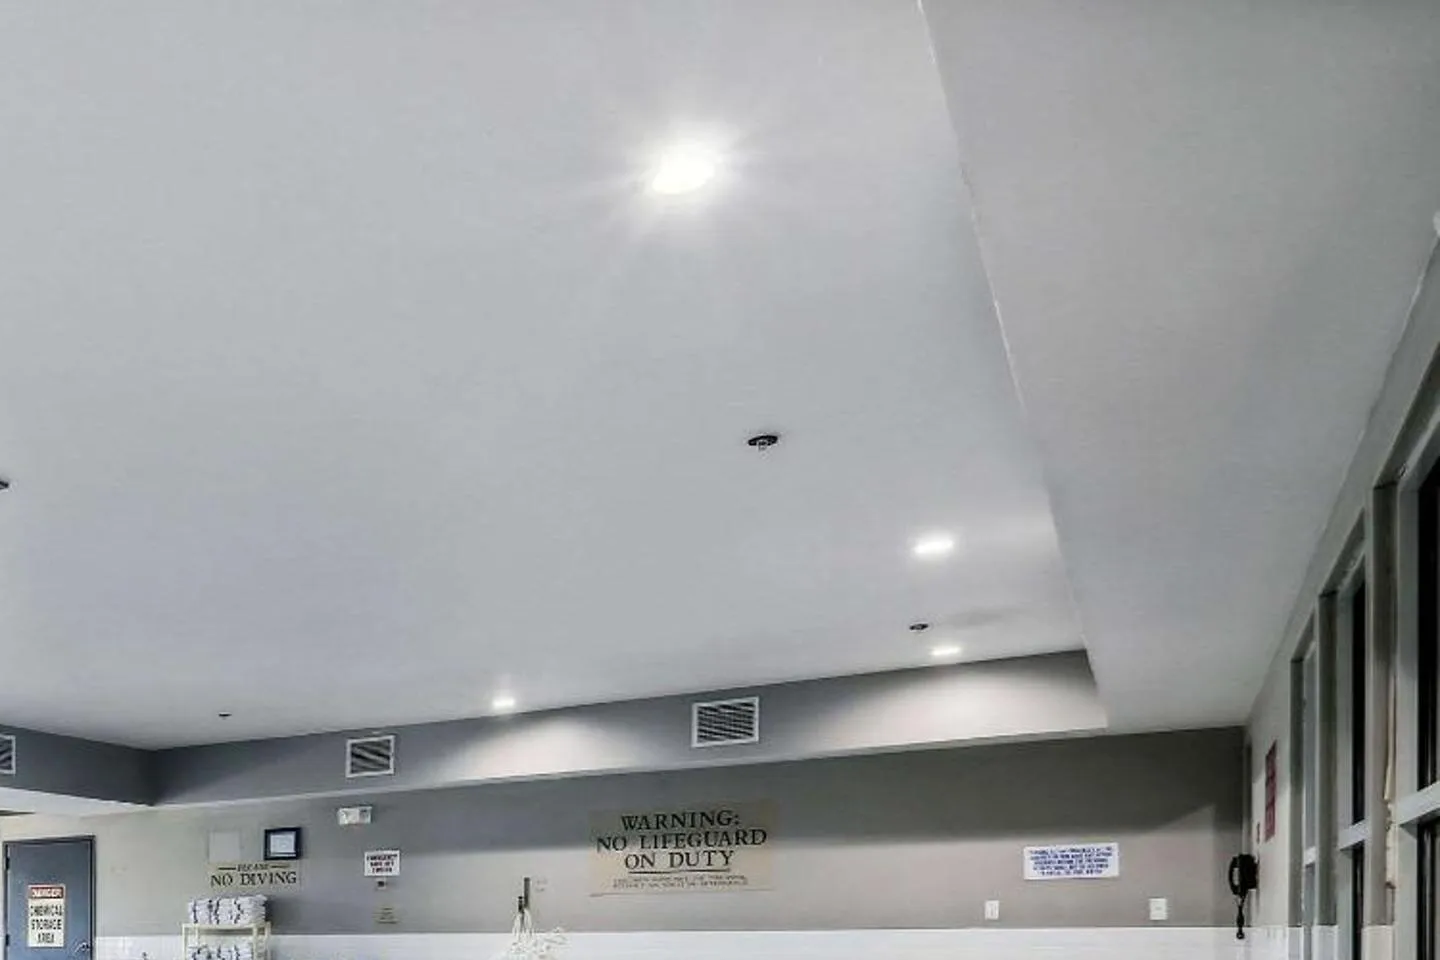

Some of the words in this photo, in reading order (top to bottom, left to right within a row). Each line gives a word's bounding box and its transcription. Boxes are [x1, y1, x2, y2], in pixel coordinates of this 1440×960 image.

[620, 810, 740, 831] WARNING:
[597, 835, 628, 852] NO
[639, 829, 768, 850] LIFEGUARD
[624, 853, 657, 870] ON
[669, 850, 735, 869] DUTY
[210, 874, 234, 887] NO
[240, 871, 297, 886] DIVING
